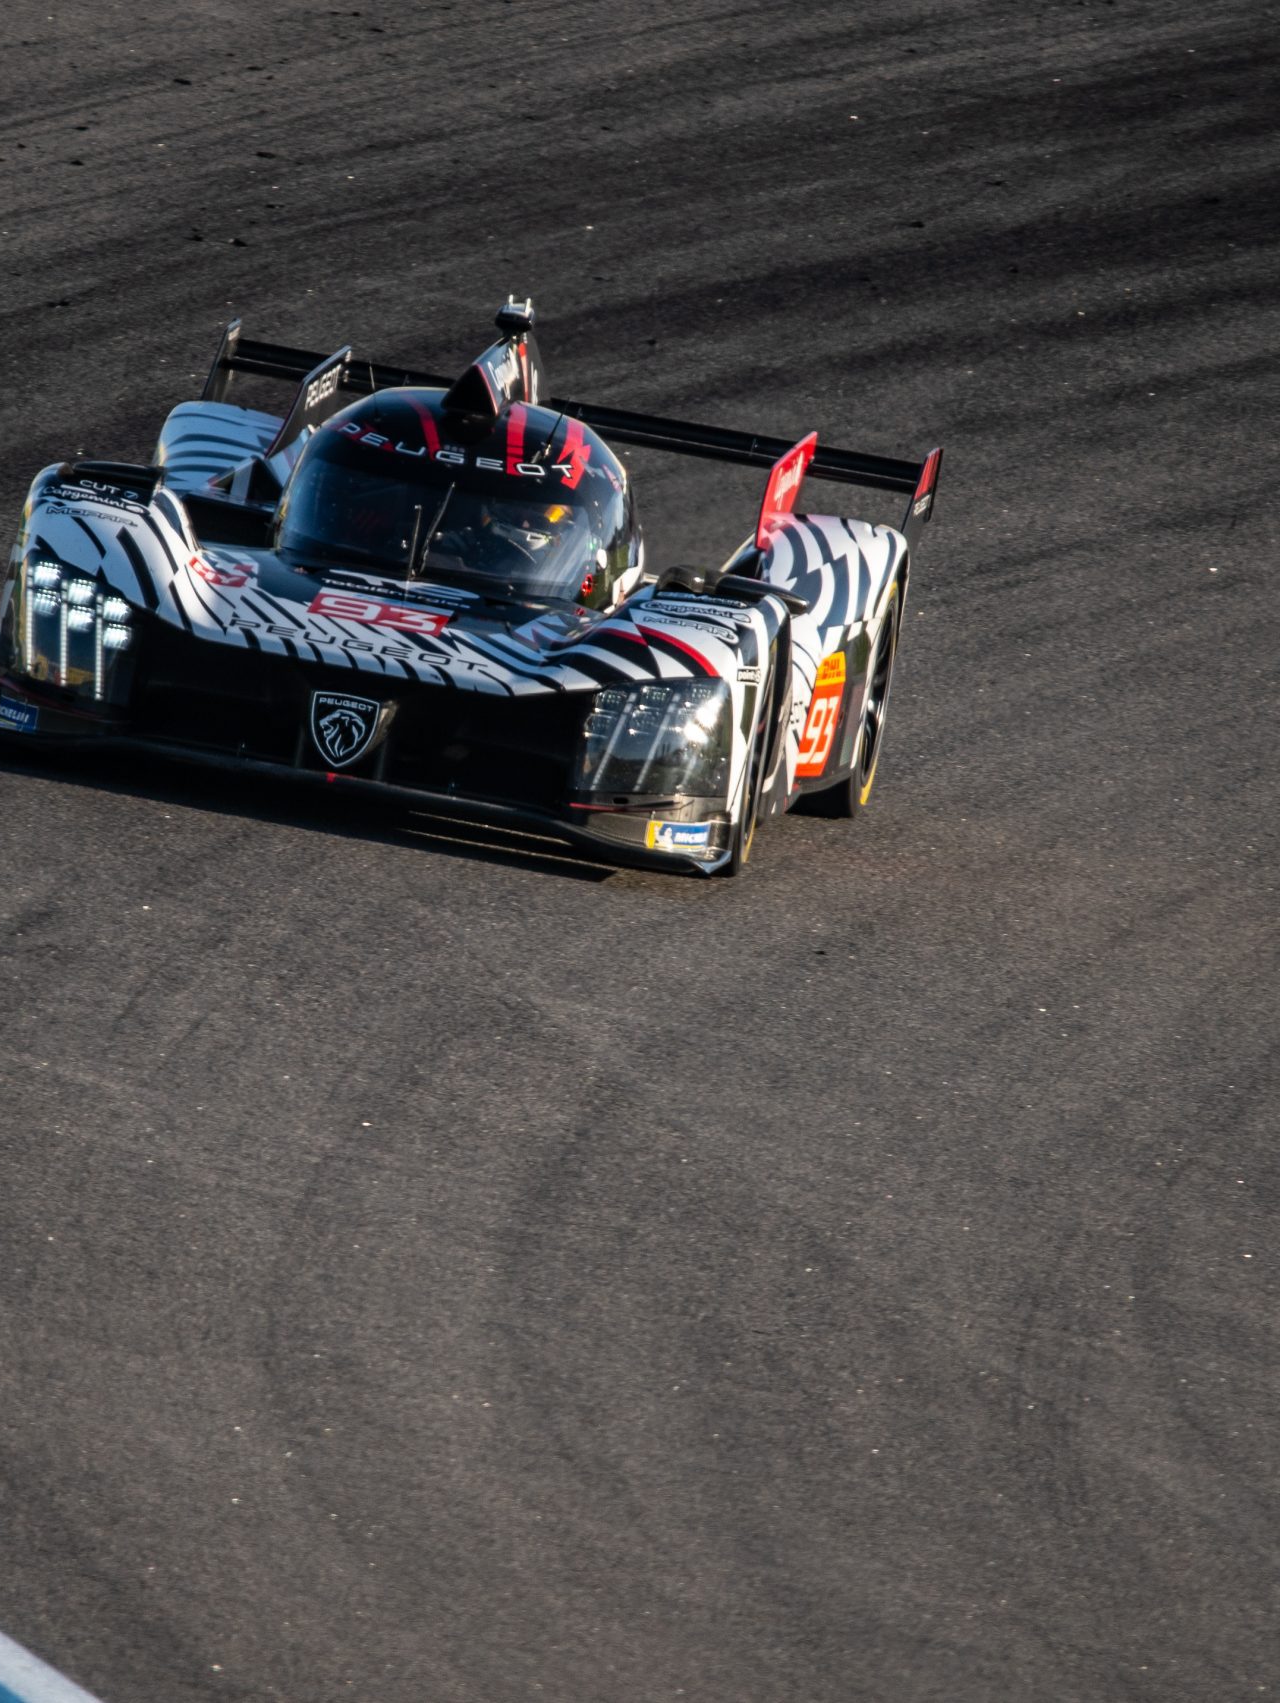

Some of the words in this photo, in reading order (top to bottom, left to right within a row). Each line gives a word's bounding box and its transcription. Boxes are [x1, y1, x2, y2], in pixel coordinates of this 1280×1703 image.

[304, 363, 342, 411] PEUGEOT
[338, 421, 575, 479] PEUGEOT
[42, 486, 125, 509] Capgemini
[79, 479, 121, 495] CUT
[318, 596, 438, 632] 93
[229, 618, 489, 672] PEUGEOT
[319, 697, 374, 713] PEUGEOT
[797, 696, 840, 764] 93
